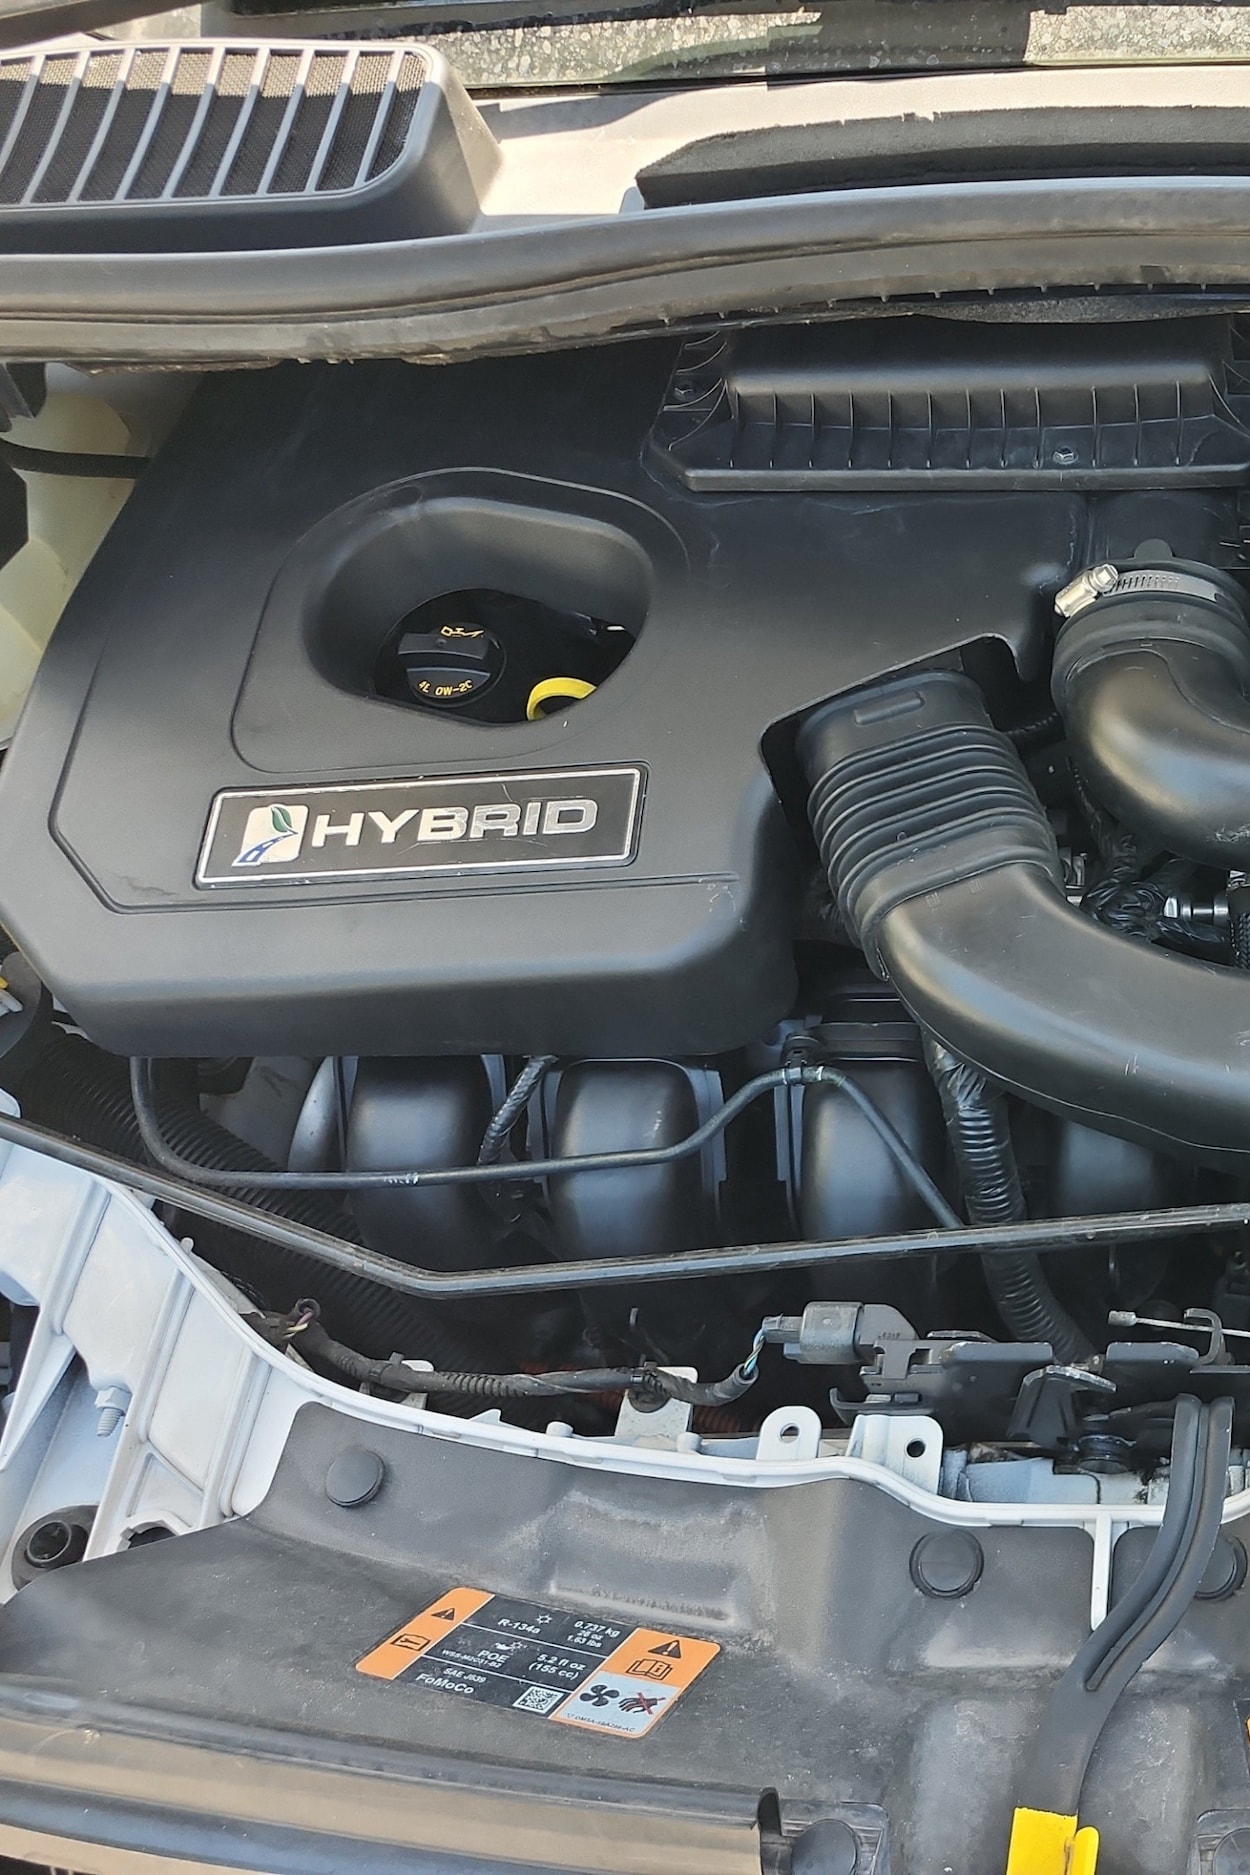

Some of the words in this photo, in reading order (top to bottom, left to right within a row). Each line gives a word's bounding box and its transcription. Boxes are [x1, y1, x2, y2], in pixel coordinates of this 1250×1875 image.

[312, 799, 598, 848] HYBRID
[498, 1618, 540, 1634] R-134a
[574, 1621, 606, 1632] 0.737
[605, 1628, 620, 1638] kg
[567, 1635, 586, 1644] 1.63
[586, 1640, 602, 1648] lbs
[477, 1650, 510, 1663] POE
[537, 1654, 558, 1664] 5.2
[443, 1668, 464, 1677] SAE
[528, 1662, 558, 1674] (155
[558, 1670, 578, 1680] cc)
[416, 1674, 474, 1694] FoMoCo
